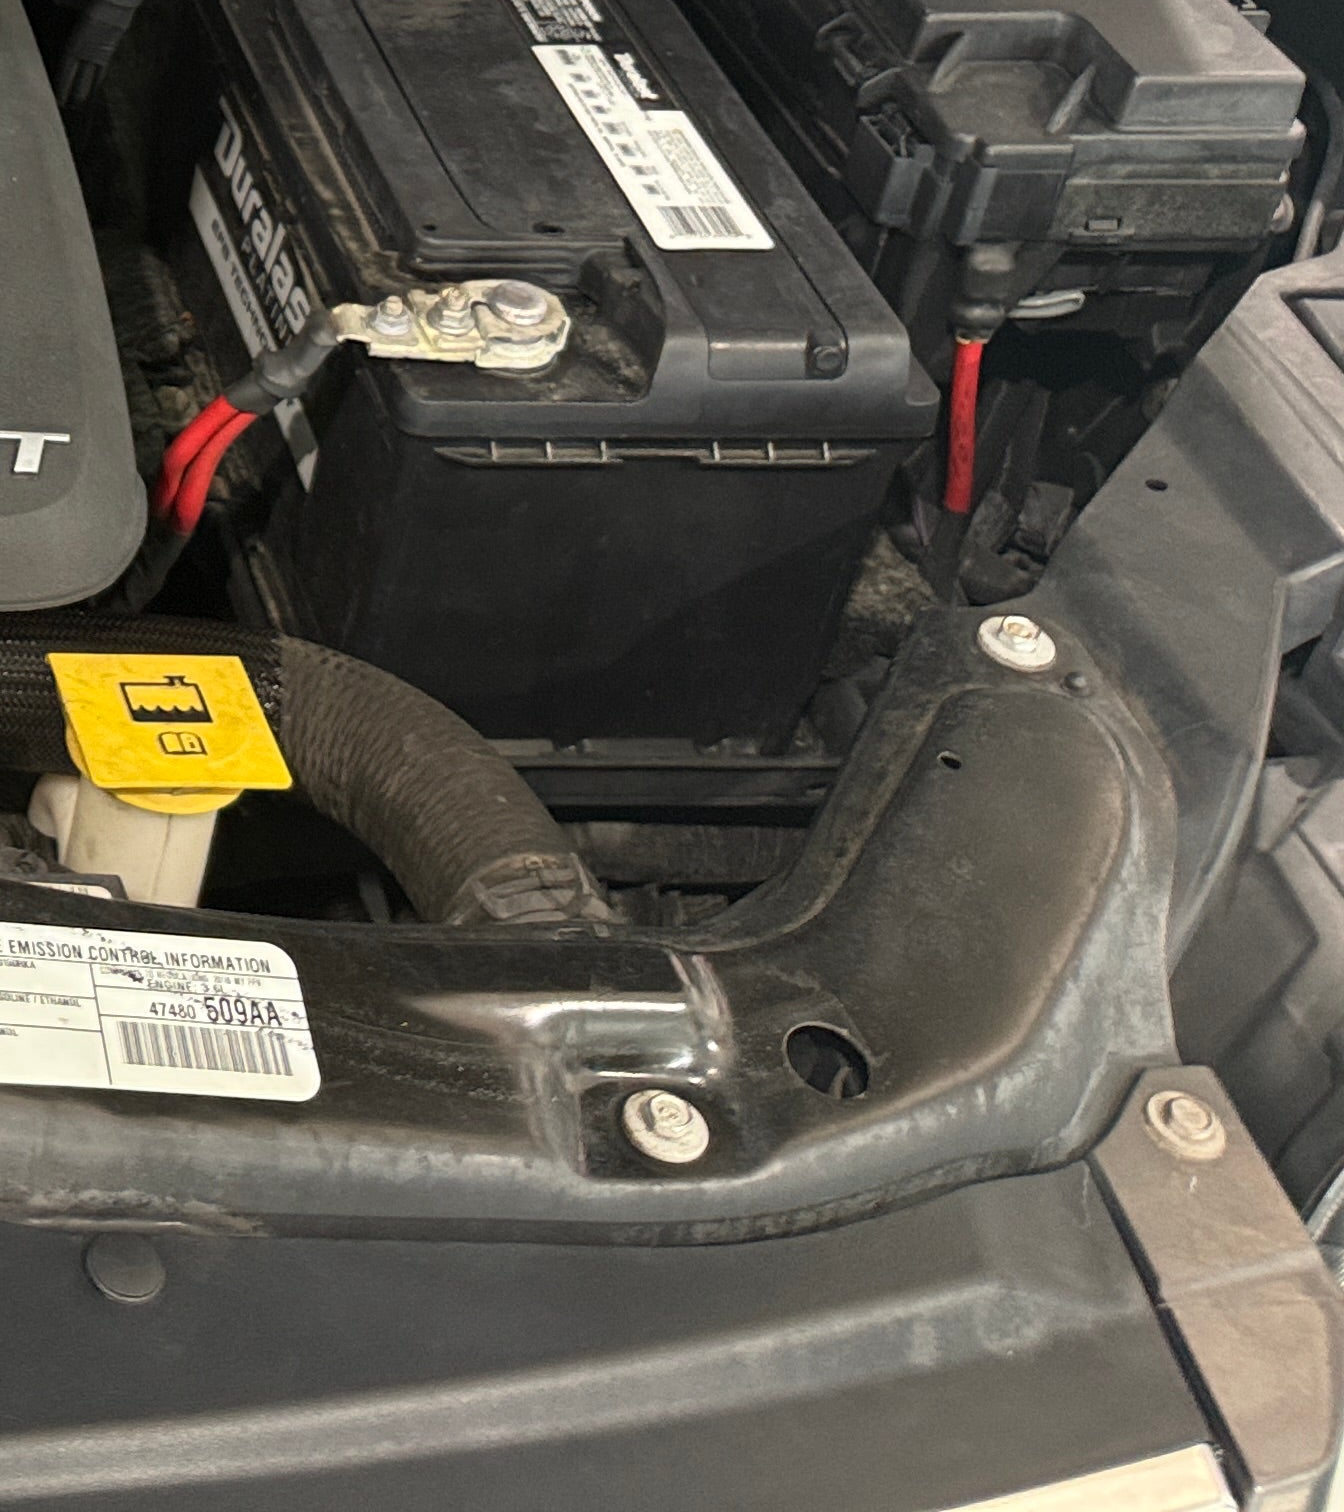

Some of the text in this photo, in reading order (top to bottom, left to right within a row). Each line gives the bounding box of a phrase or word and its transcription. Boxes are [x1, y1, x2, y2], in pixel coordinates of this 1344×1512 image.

[214, 94, 311, 336] Duralas
[8, 939, 83, 959] EMISSION
[87, 945, 161, 966] CONTROL
[164, 952, 271, 974] INFORMATION
[40, 995, 81, 1008] ETHANOL
[149, 1002, 197, 1020] 47480
